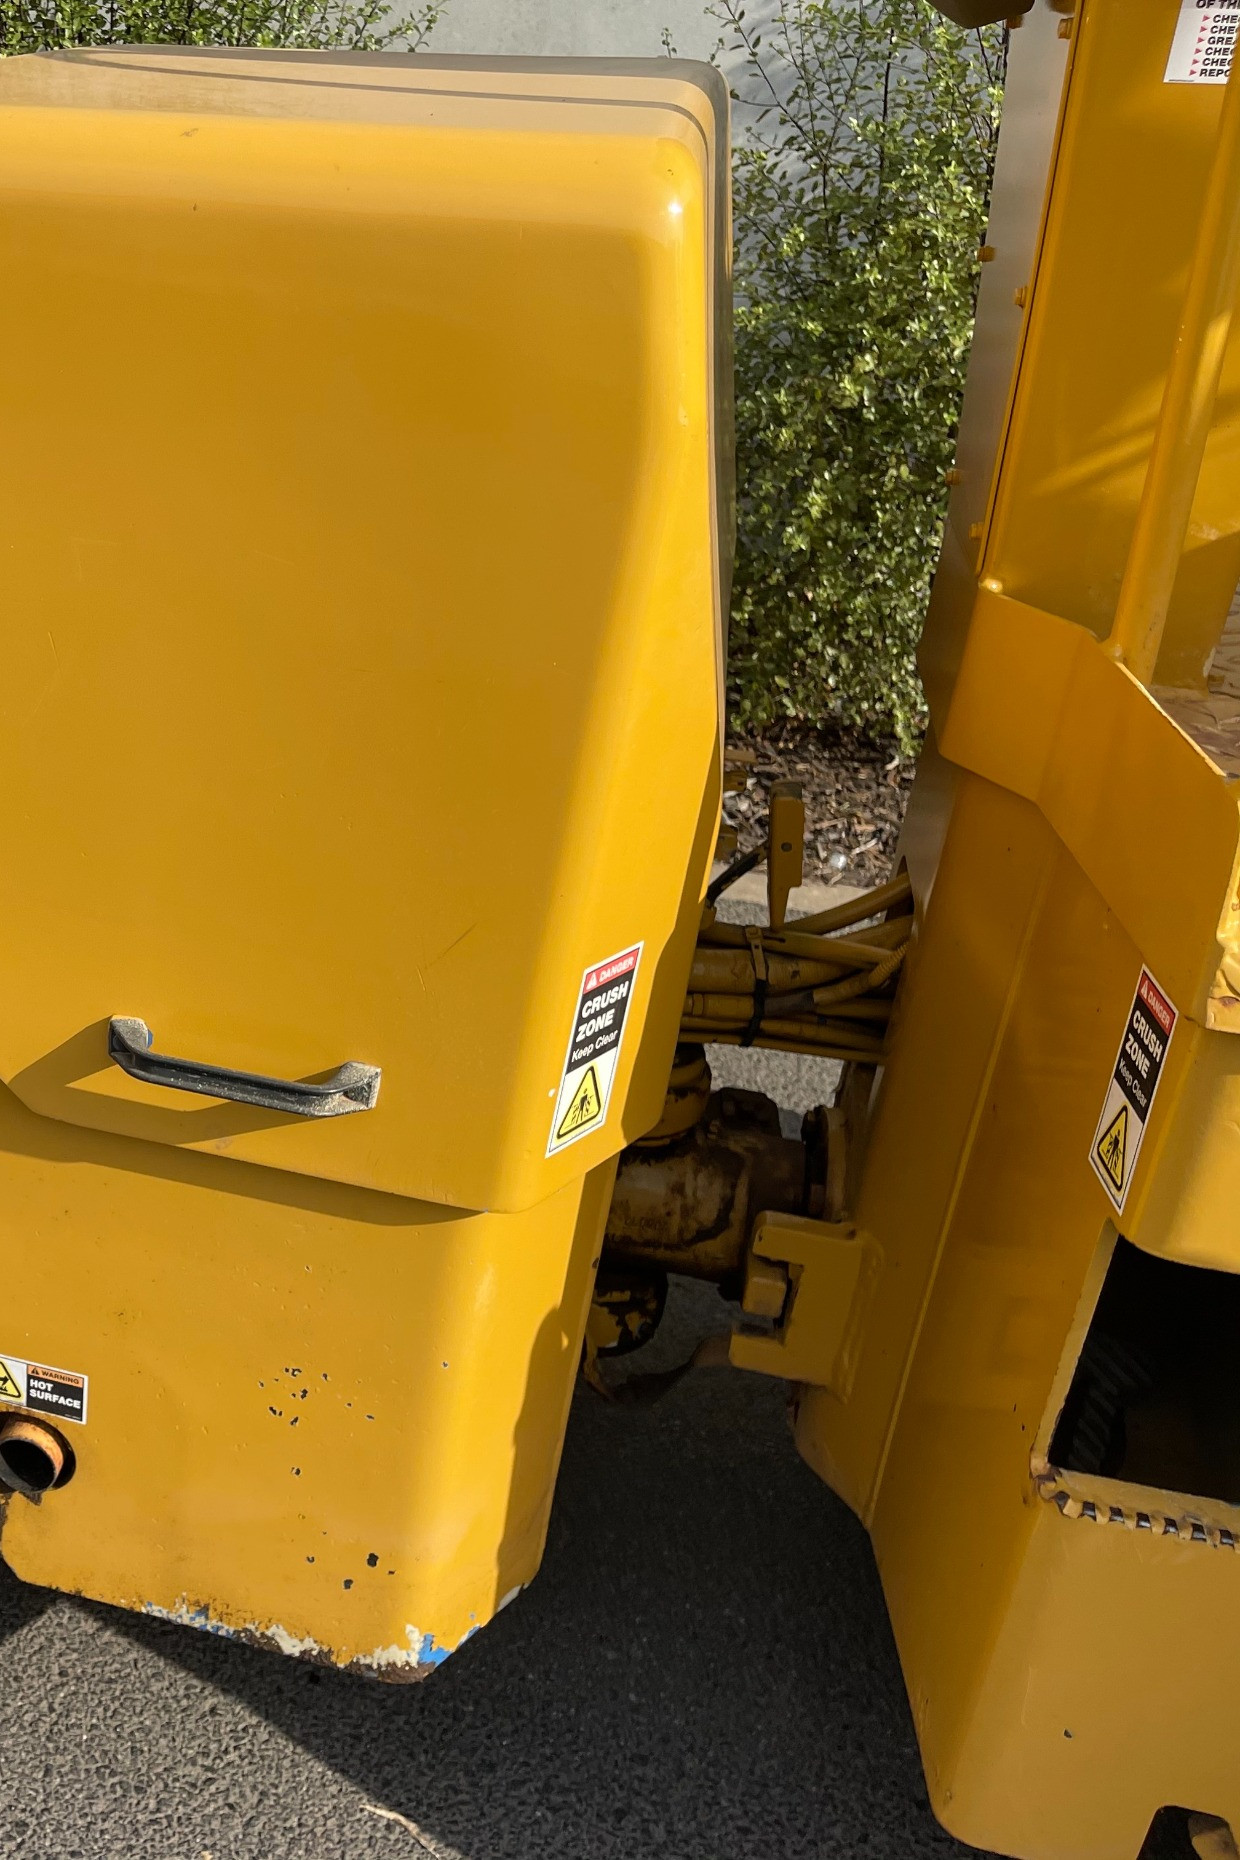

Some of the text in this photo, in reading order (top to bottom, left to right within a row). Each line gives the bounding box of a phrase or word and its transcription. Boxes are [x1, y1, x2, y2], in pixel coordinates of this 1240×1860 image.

[1196, 0, 1216, 9] OF
[1213, 15, 1240, 23] CHE
[1210, 26, 1237, 34] CHE
[598, 956, 634, 982] DANGER
[581, 980, 629, 1019] CRUSH
[1147, 990, 1171, 1029] DANGER
[575, 1008, 615, 1043] ZONE
[1133, 1010, 1163, 1063] CRUSH
[571, 1029, 618, 1063] Keep Clear
[1125, 1032, 1150, 1080] ZONE
[1119, 1056, 1147, 1107] Keep Clear
[29, 1379, 53, 1391] HOT
[41, 1371, 80, 1385] WARNING
[29, 1389, 81, 1409] SURFACE
